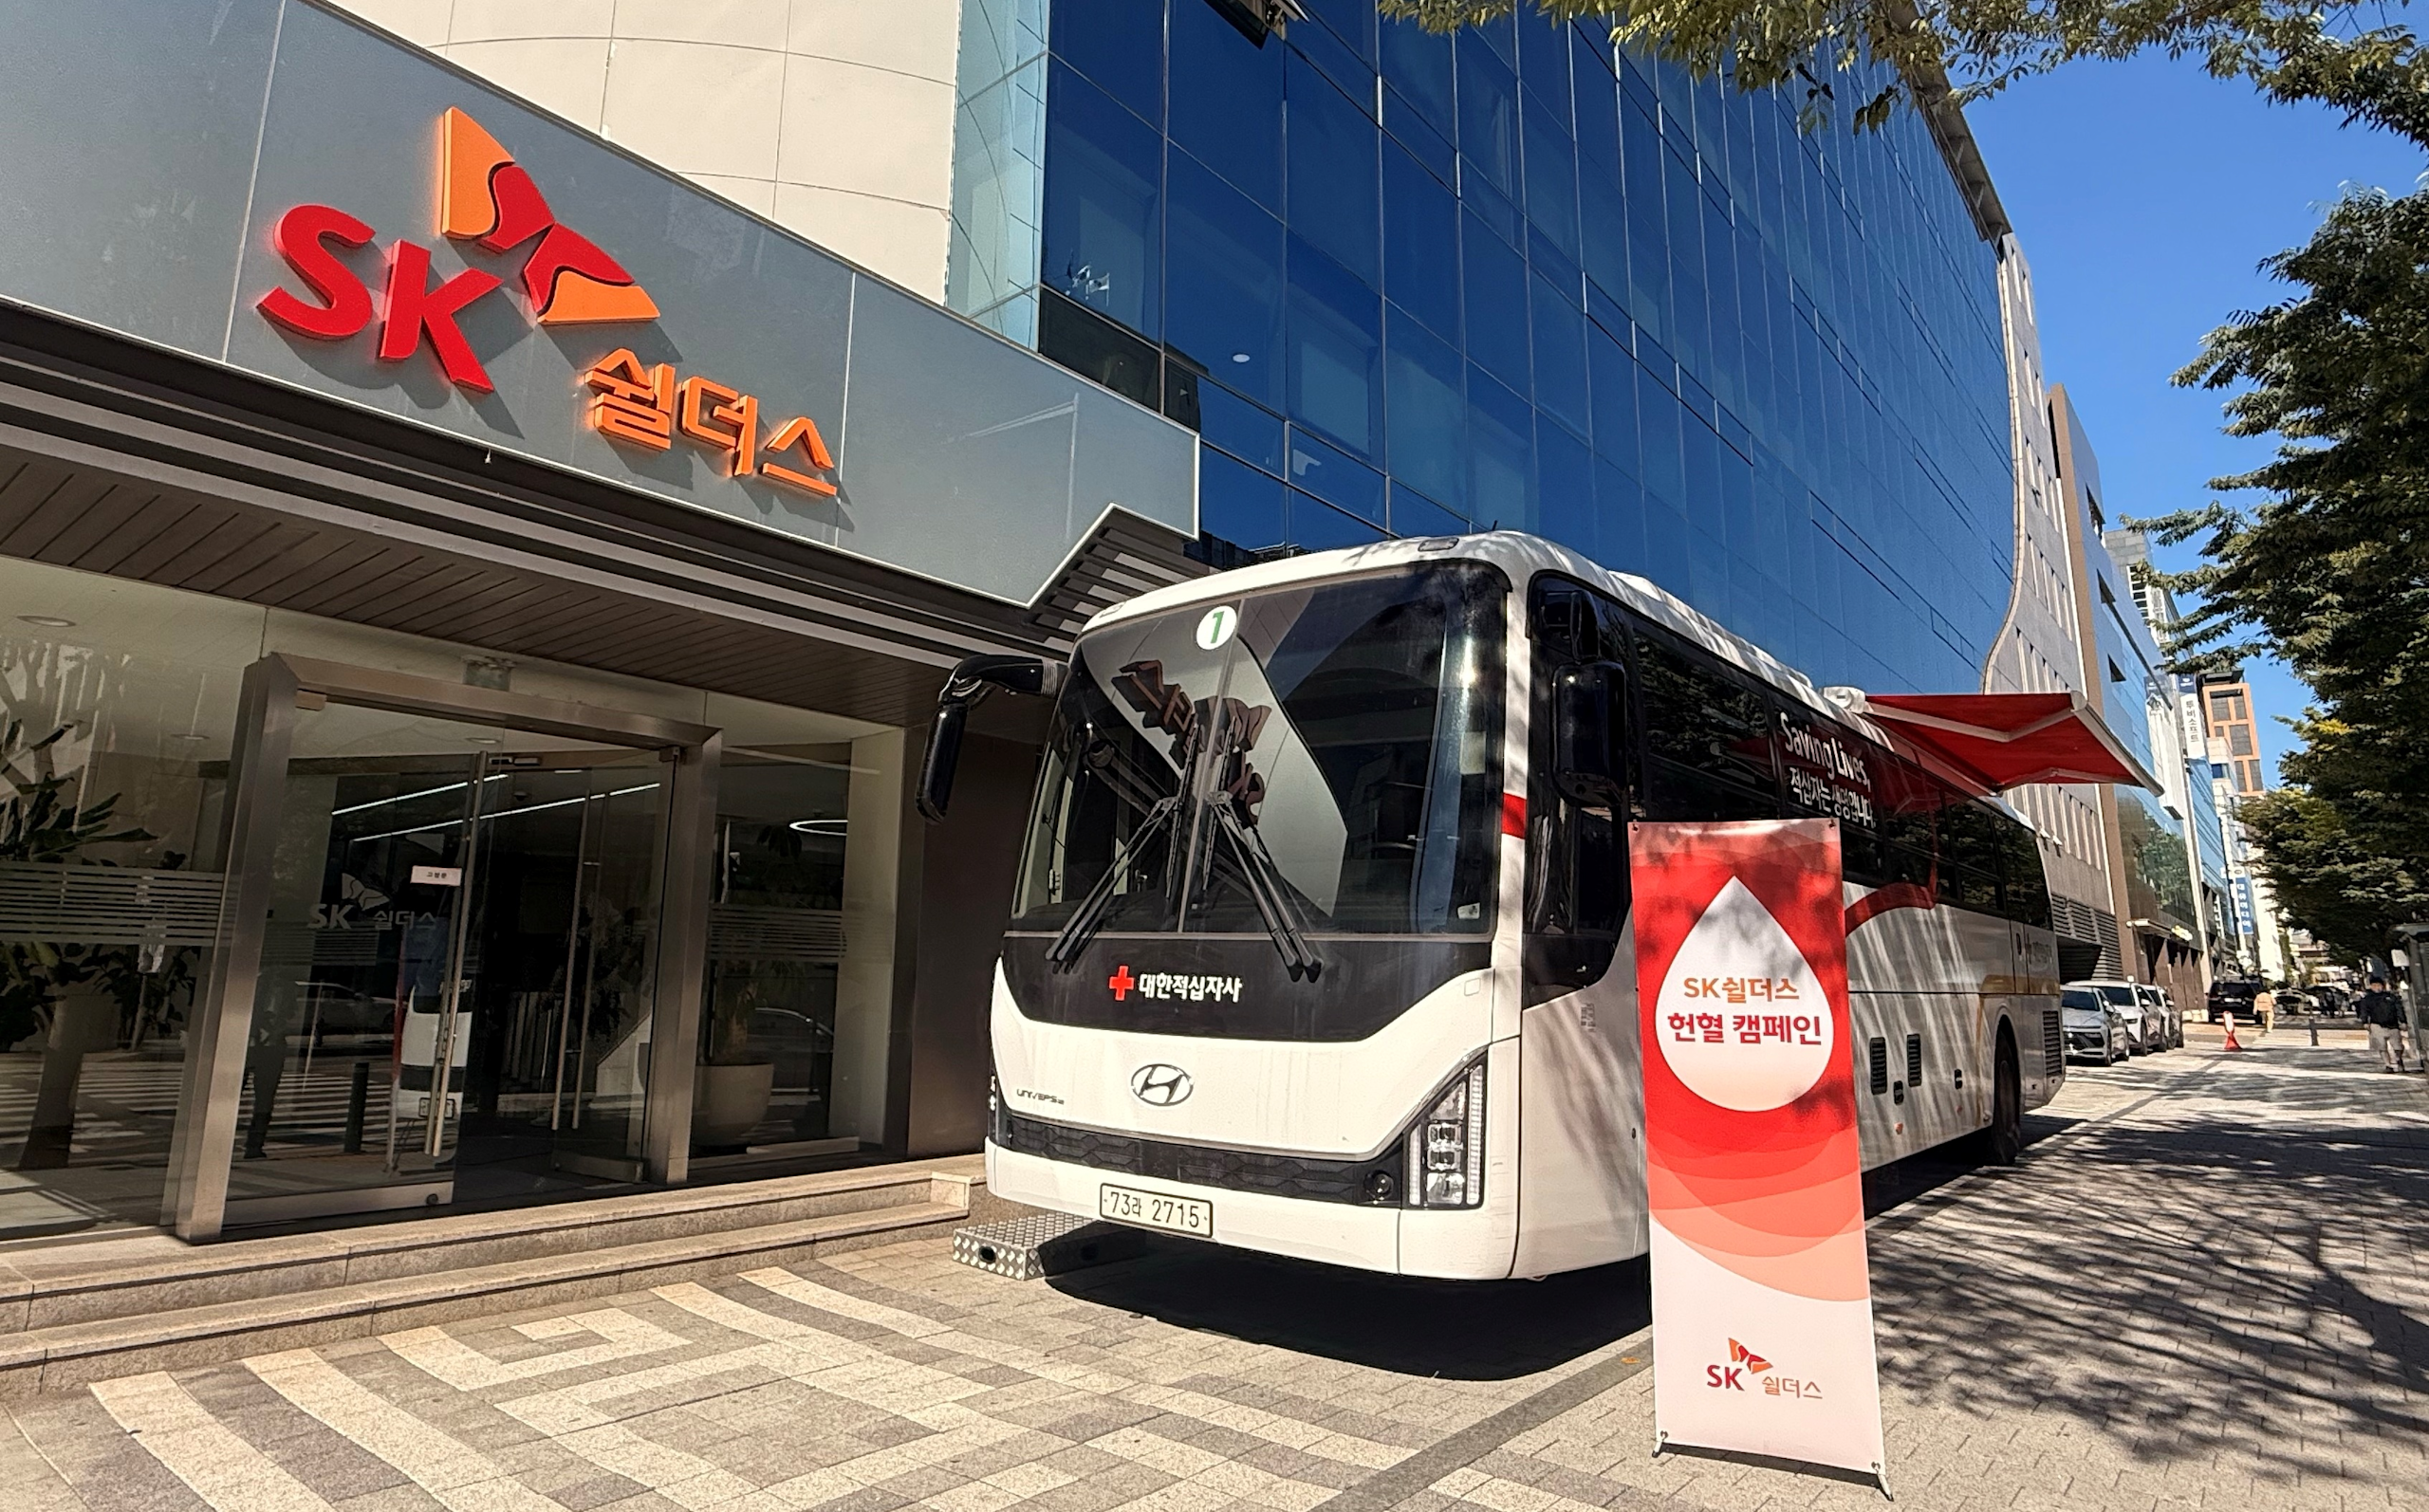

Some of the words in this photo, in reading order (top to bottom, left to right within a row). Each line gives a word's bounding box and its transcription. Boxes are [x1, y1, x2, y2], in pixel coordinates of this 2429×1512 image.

[255, 203, 504, 394] SK
[584, 347, 838, 497] 쉴더스
[1210, 610, 1225, 644] 1
[1780, 711, 1835, 781] Saving
[1789, 766, 1832, 813] 적십자는
[306, 903, 354, 930] SK
[373, 910, 436, 931] 쉴더스
[1139, 972, 1242, 1003] 대한적십자사
[1667, 1012, 1724, 1043] 헌혈
[1733, 1015, 1822, 1045] 캠페인
[1110, 1191, 1141, 1217] 73라
[1152, 1199, 1199, 1228] 2715
[1706, 1364, 1745, 1392] SK
[1762, 1375, 1823, 1399] 쉴더스
